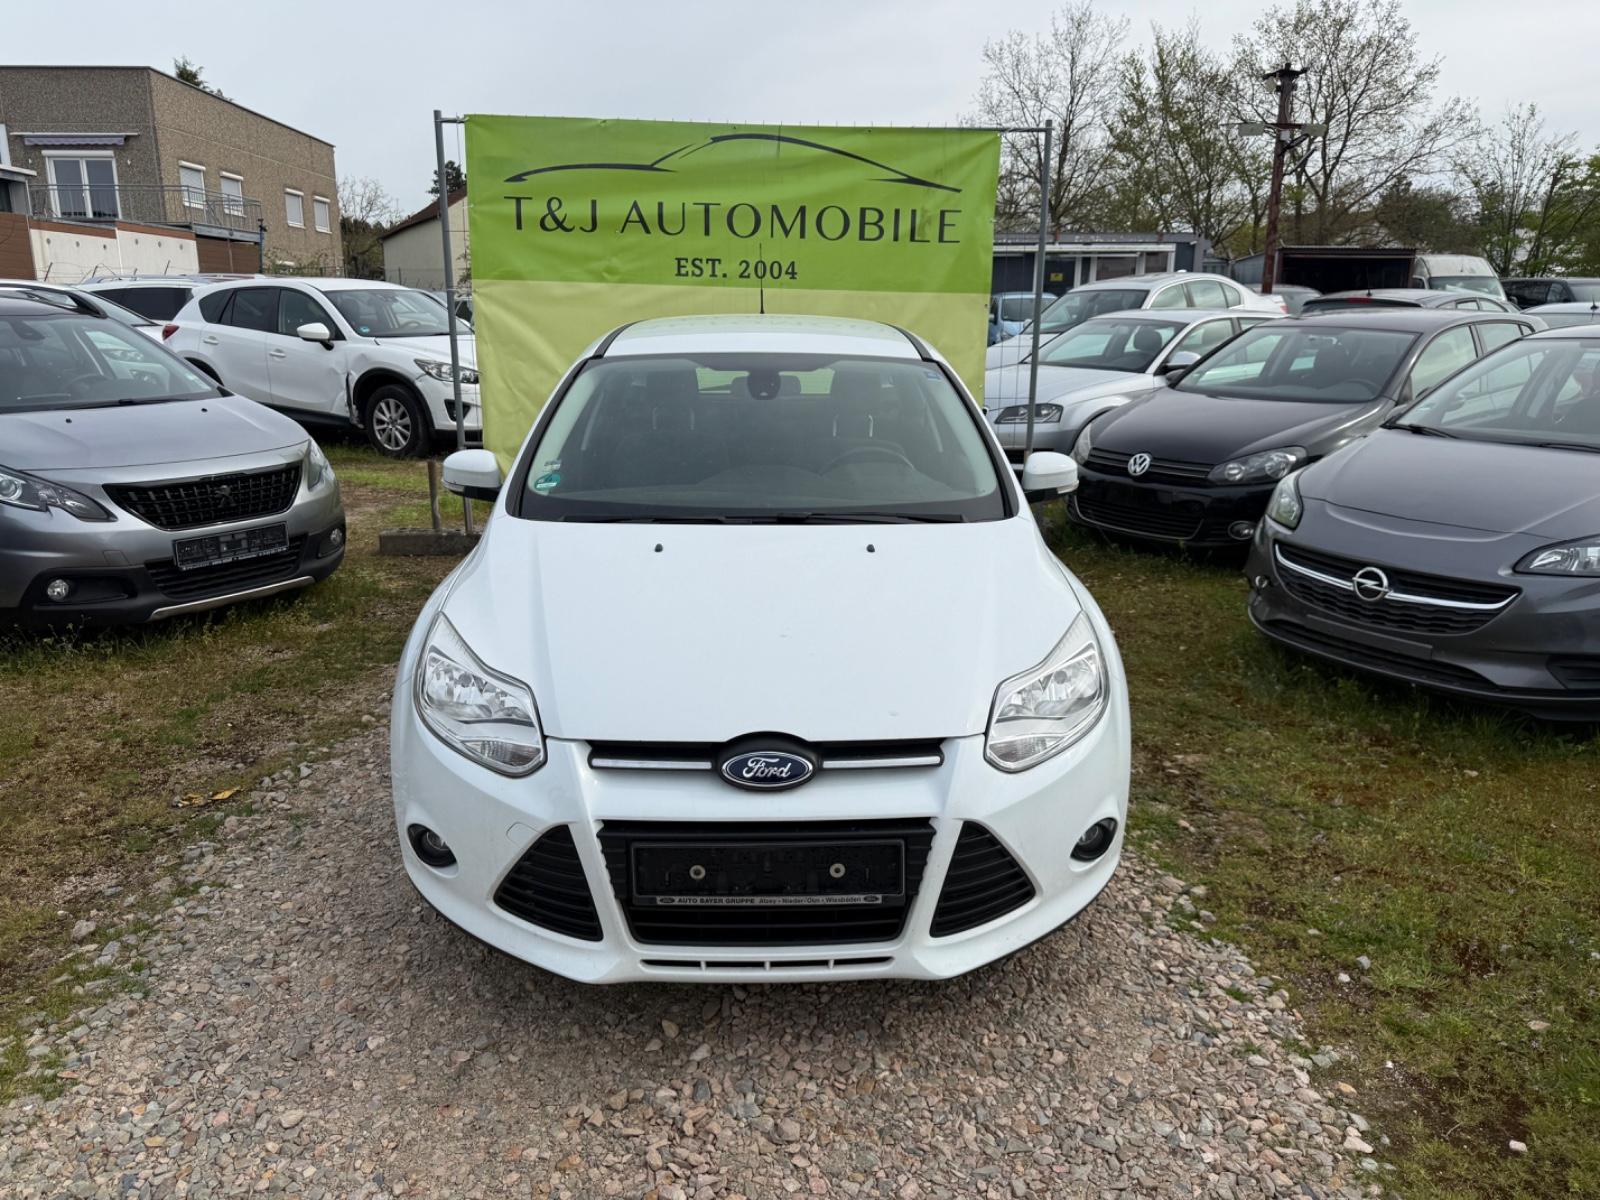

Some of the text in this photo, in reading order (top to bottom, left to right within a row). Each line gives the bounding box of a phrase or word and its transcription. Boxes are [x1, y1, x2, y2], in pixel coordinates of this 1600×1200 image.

[503, 196, 962, 244] T&J AUTOMOBILE
[674, 257, 798, 280] EST. 2004
[742, 756, 792, 778] Ford
